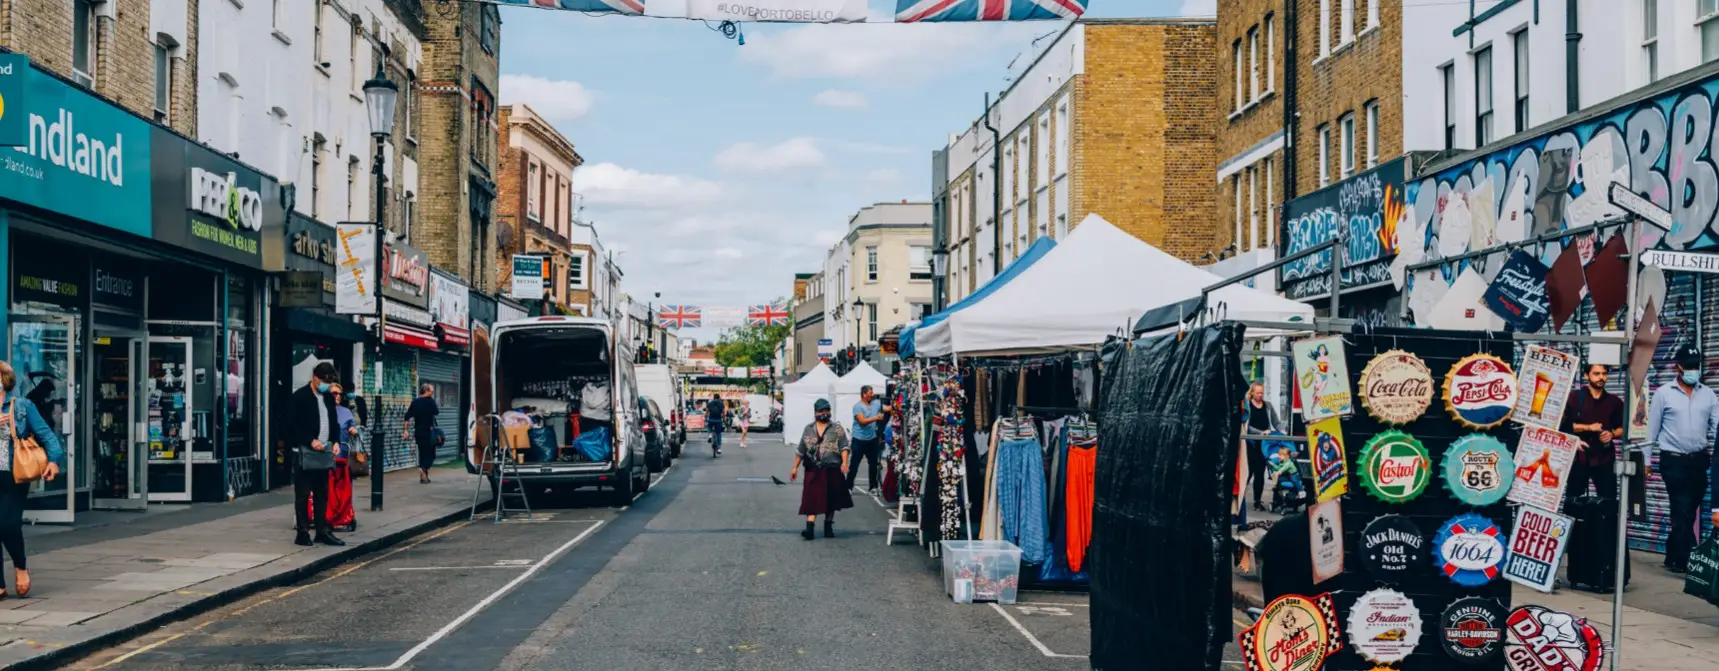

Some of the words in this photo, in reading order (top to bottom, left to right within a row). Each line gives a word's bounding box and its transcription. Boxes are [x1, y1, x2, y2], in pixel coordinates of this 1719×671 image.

[43, 278, 59, 294] VALUE
[96, 268, 133, 297] Entrance
[1529, 350, 1572, 370] BEER
[1526, 429, 1574, 450] CHEERS
[1379, 455, 1422, 485] Castrol
[1467, 470, 1493, 487] 66
[1520, 510, 1553, 535] COLD
[1365, 531, 1389, 549] JACK
[1382, 545, 1405, 554] Old
[1512, 527, 1559, 564] BEER
[1449, 541, 1494, 564] 1664
[1509, 555, 1548, 583] HERE!
[1366, 611, 1409, 623] Indian
[1450, 606, 1496, 622] GENUINE
[1447, 630, 1498, 638] HARLEY-DAVIDSON
[1270, 626, 1310, 664] Mom's
[1281, 640, 1320, 671] Diner
